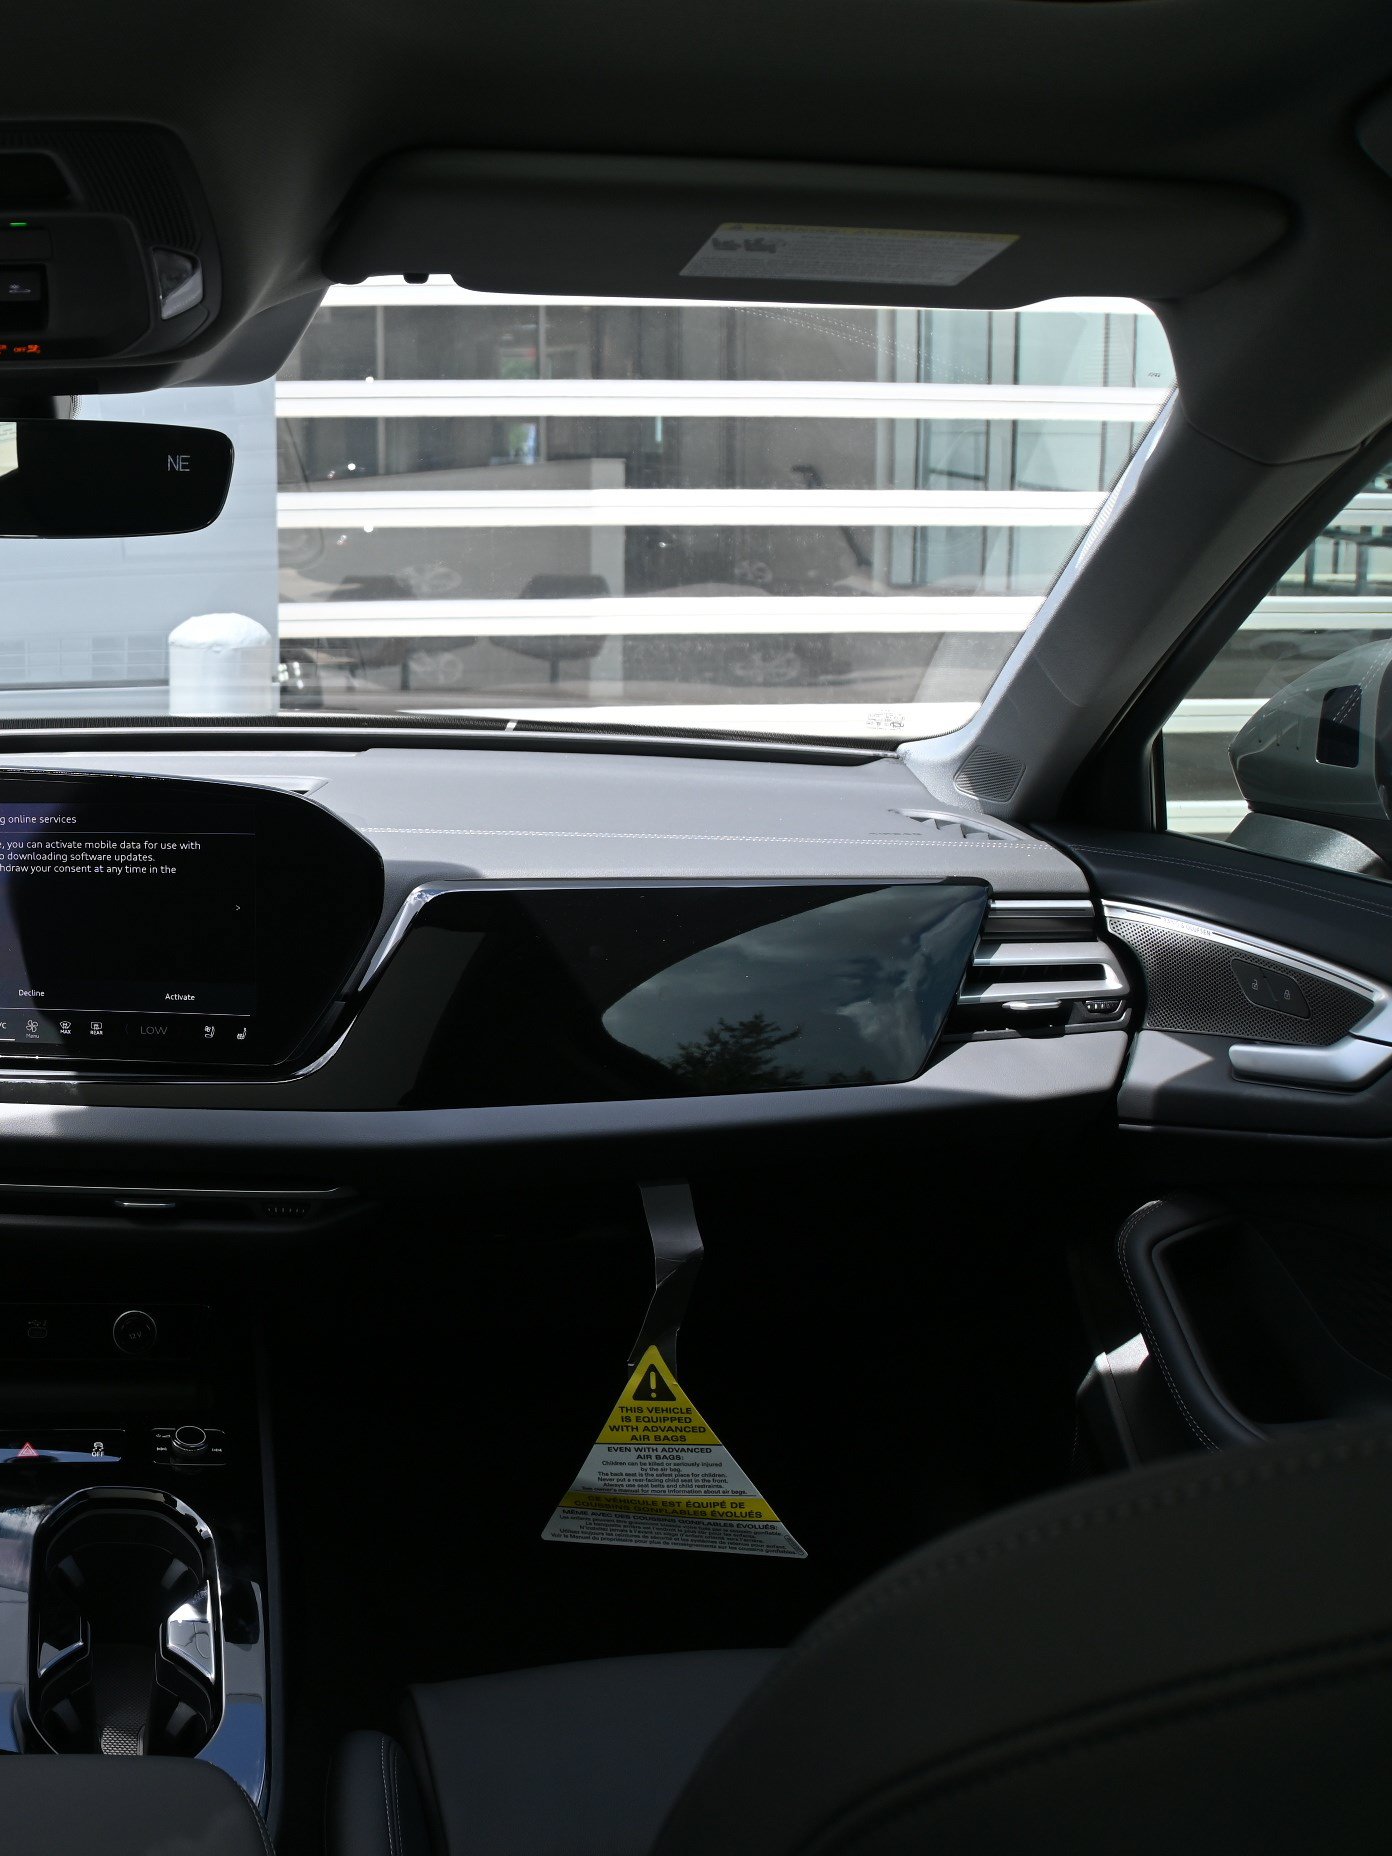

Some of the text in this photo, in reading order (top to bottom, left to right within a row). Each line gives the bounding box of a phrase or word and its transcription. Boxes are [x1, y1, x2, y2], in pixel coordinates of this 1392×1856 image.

[168, 455, 190, 471] NE
[8, 815, 36, 824] online
[39, 815, 77, 824] services
[7, 841, 24, 850] you
[26, 841, 43, 849] can
[45, 840, 82, 849] activate
[85, 840, 117, 849] mobile
[120, 840, 141, 849] data
[143, 840, 158, 850] for
[160, 842, 177, 850] use
[179, 841, 201, 850] with
[7, 852, 68, 862] downloading
[70, 852, 112, 861] software
[114, 853, 155, 862] updates.
[31, 865, 51, 874] your
[53, 865, 91, 873] consent
[94, 865, 104, 873] at
[106, 866, 122, 875] any
[125, 865, 147, 873] time
[149, 865, 158, 873] in
[160, 865, 176, 874] the
[140, 1026, 168, 1035] LOW
[711, 1509, 762, 1518] ÉVOLUÉS
